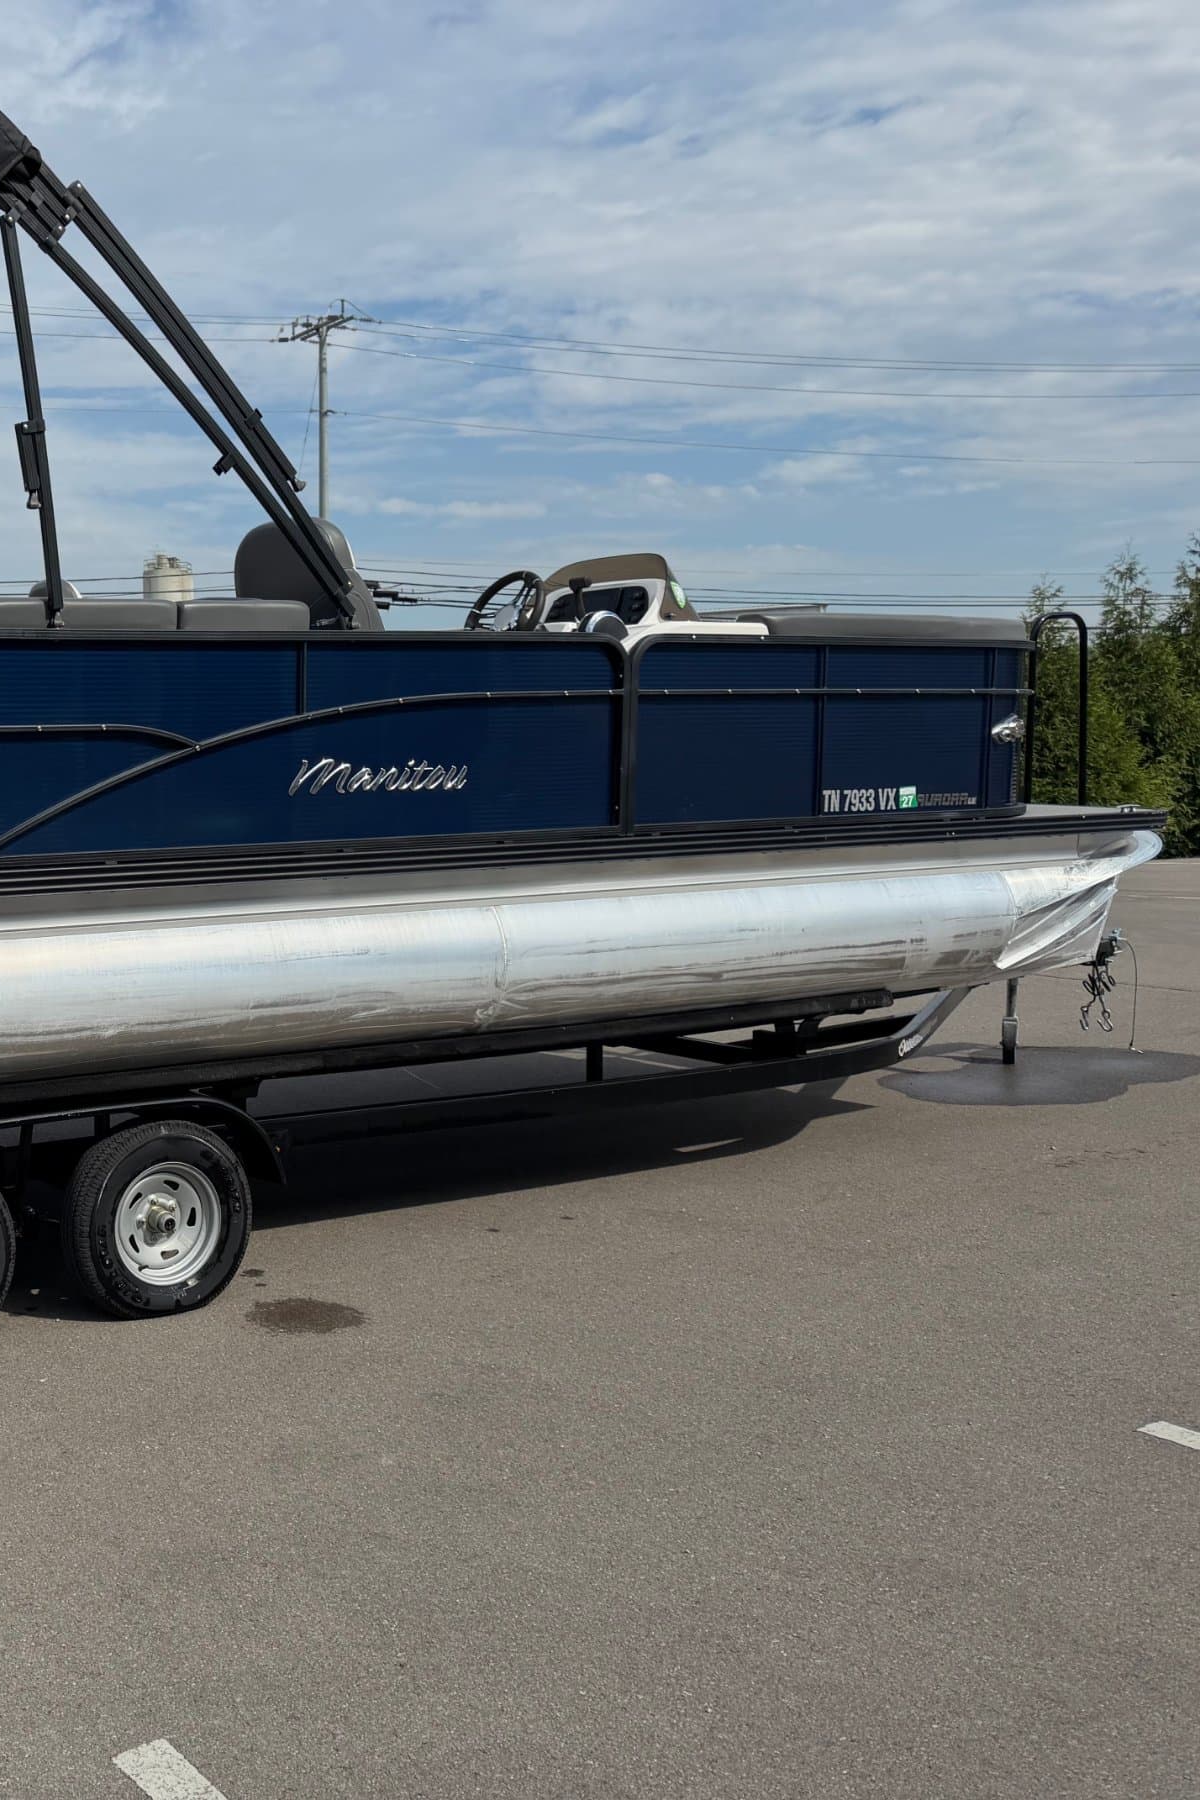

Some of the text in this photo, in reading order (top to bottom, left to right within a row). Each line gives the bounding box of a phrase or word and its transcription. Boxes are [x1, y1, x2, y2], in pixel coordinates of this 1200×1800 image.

[288, 757, 467, 796] Manitou
[822, 787, 897, 812] TN 7933 VX
[902, 795, 914, 808] 27
